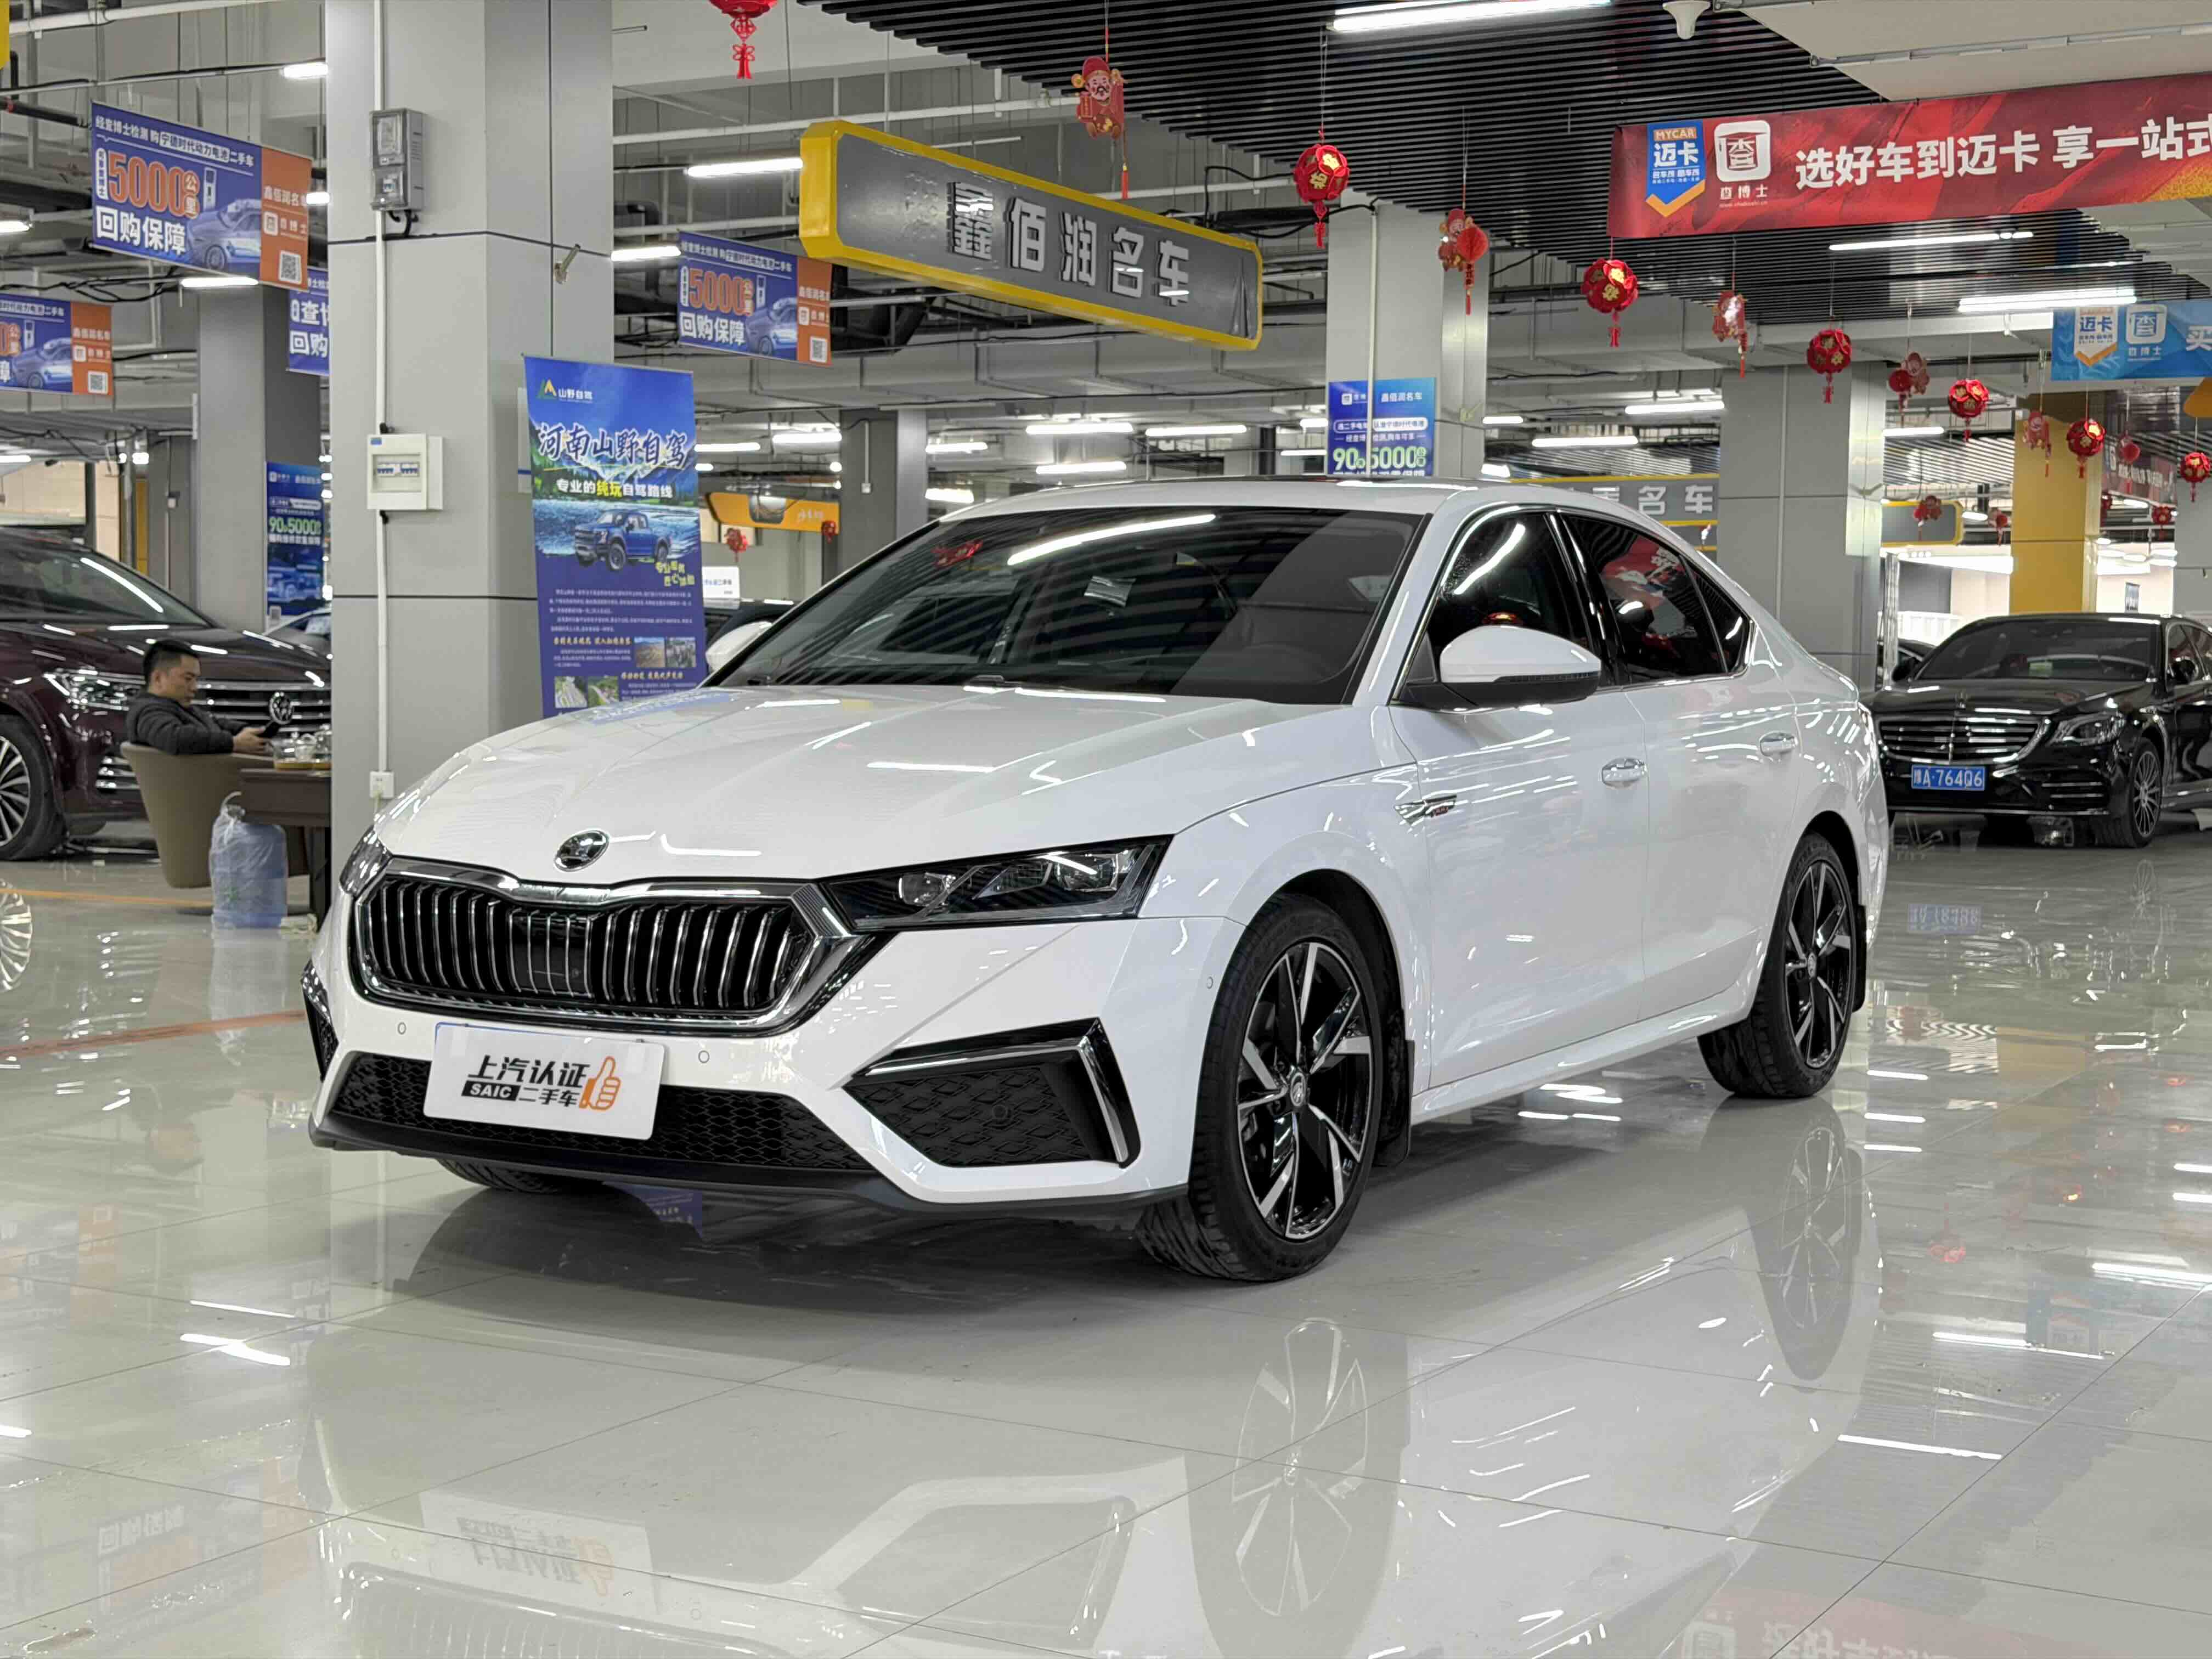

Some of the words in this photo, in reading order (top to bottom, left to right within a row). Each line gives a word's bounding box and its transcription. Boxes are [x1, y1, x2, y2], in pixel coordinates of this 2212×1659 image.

[1655, 128, 1695, 140] MYCAR
[1654, 141, 1699, 167] 迈卡
[1795, 130, 2041, 190] 选好车到迈卡
[95, 205, 186, 255] 回购保障
[948, 182, 1190, 307] 鑫佰润名车
[680, 312, 746, 346] 回购保障
[2080, 316, 2113, 332] 迈卡
[290, 330, 328, 358] 回购
[538, 422, 687, 470] 河南山野自驾
[467, 1054, 591, 1088] 上汽认证
[470, 1083, 512, 1099] SAIC
[518, 1087, 580, 1108] 二手车
